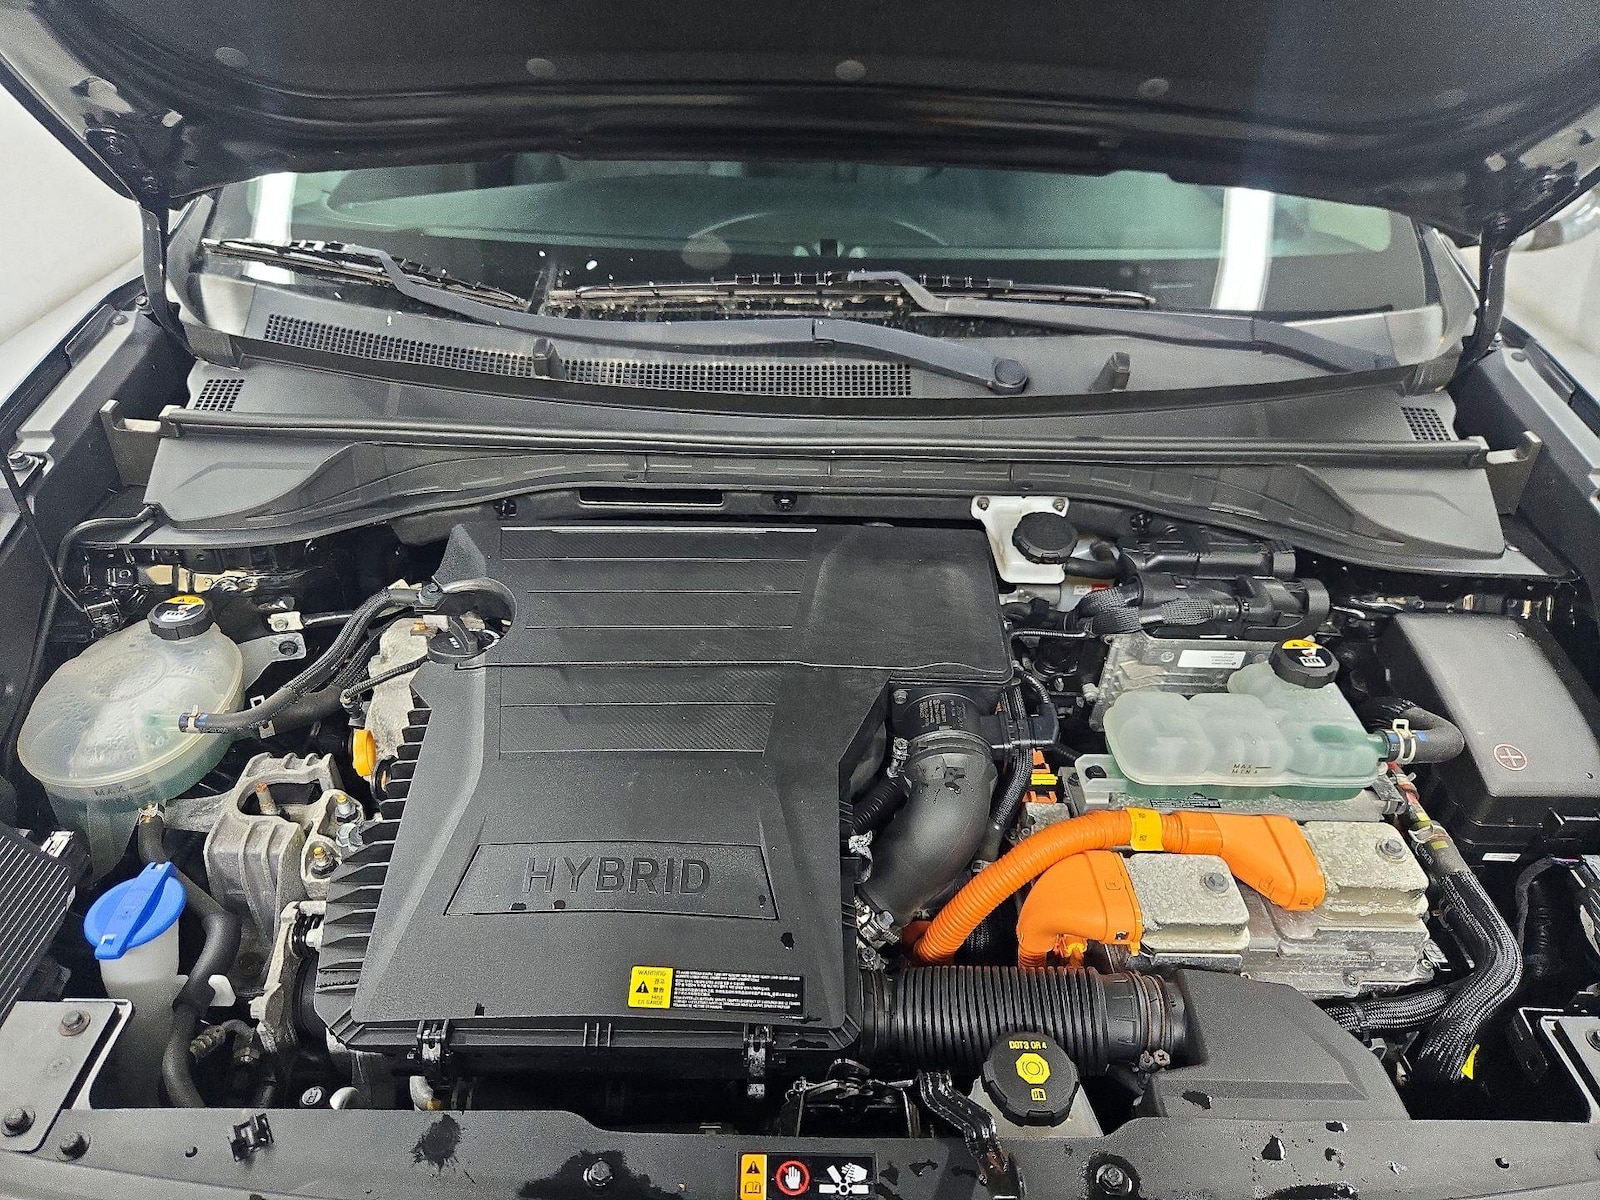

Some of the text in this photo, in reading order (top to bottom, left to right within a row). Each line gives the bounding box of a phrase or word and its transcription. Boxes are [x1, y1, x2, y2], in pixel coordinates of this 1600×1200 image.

[521, 856, 711, 895] HYBRID
[1008, 1040, 1030, 1050] DOT3
[1030, 1041, 1042, 1050] OR
